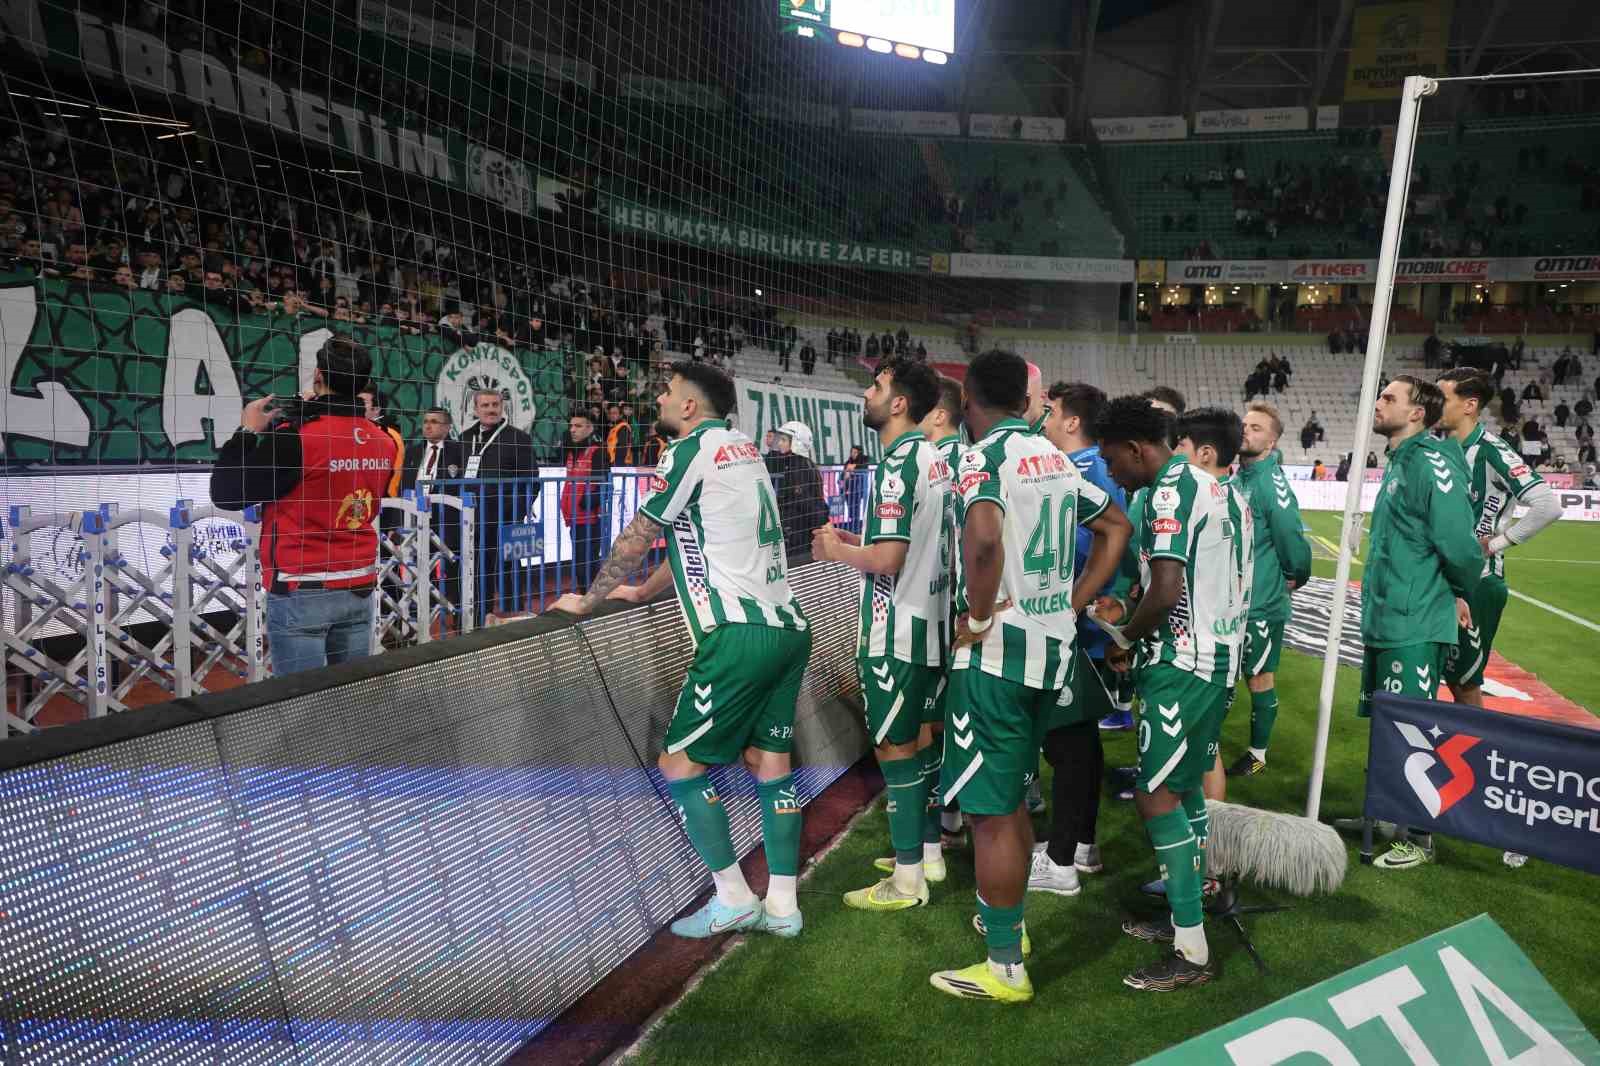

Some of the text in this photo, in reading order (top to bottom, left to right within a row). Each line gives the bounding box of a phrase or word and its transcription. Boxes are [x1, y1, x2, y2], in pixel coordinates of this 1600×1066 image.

[614, 204, 657, 233] HER
[837, 242, 911, 267] ZAFER!
[446, 343, 530, 412] KONYASPOR
[329, 458, 360, 472] SPOR
[757, 479, 783, 548] 4
[1023, 490, 1077, 590] 40
[503, 537, 544, 560] POLİS
